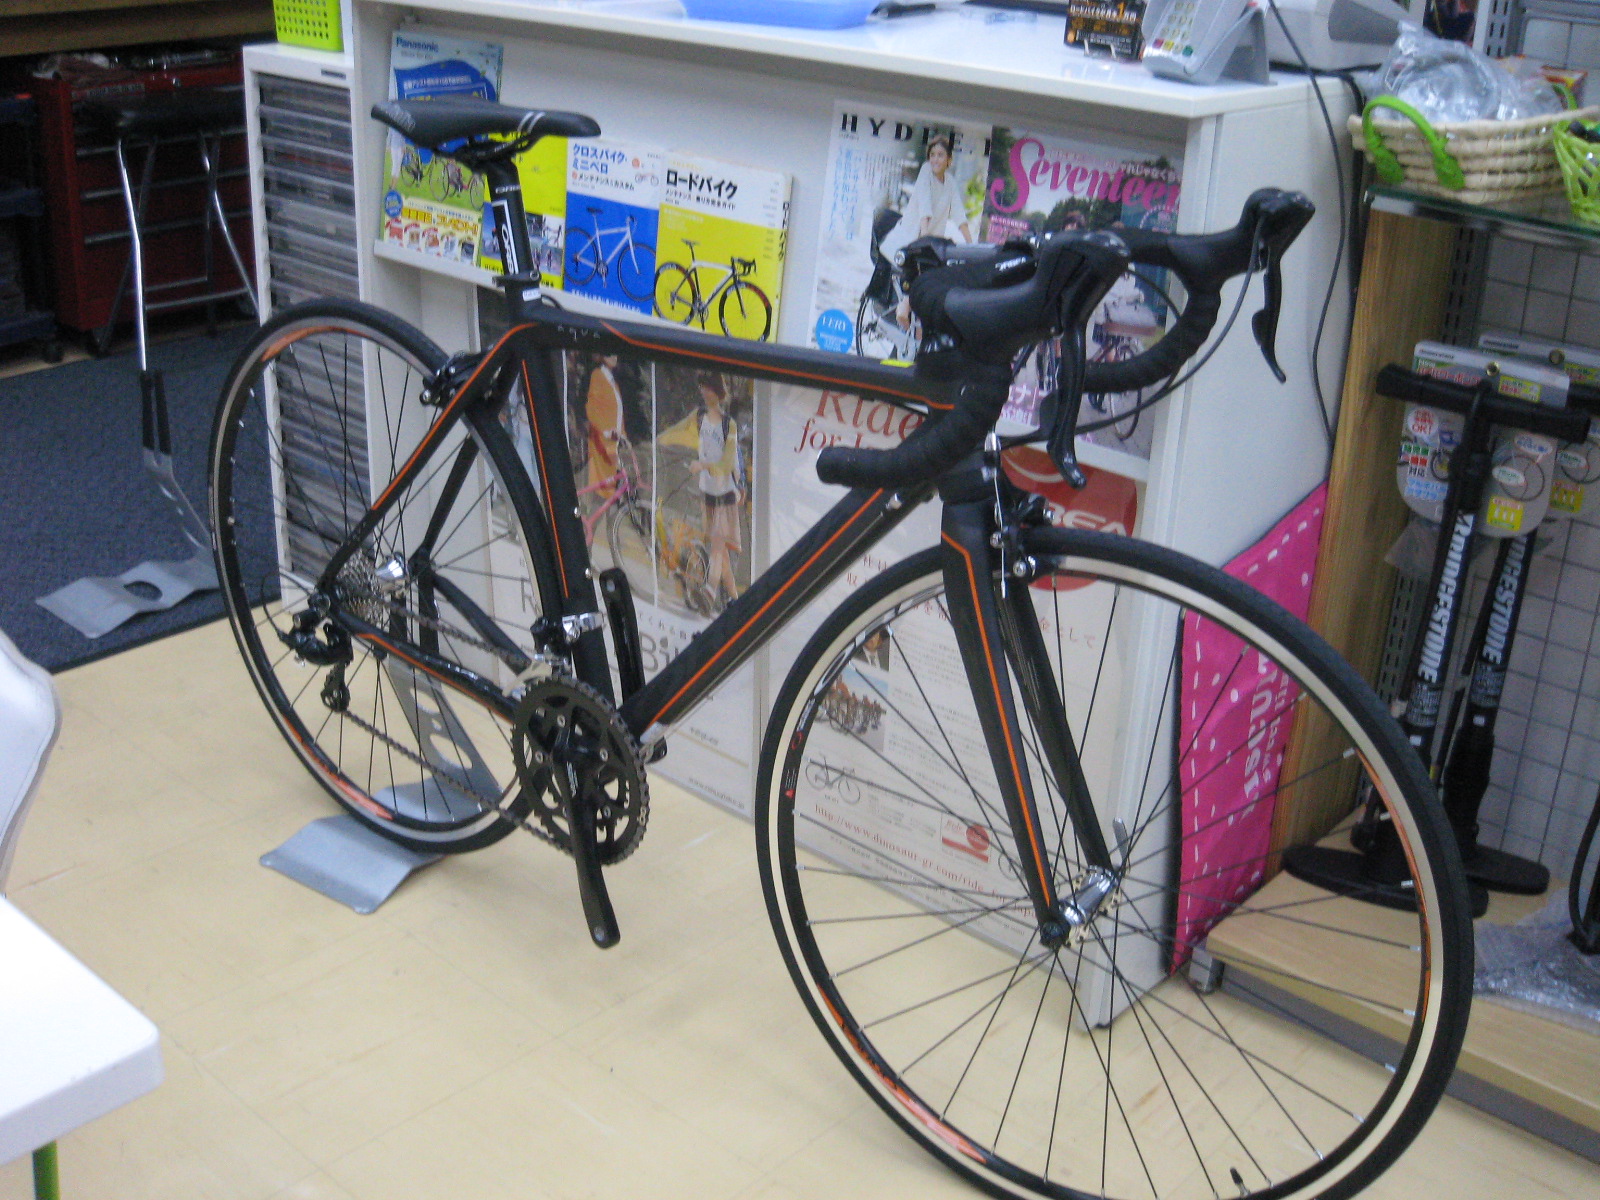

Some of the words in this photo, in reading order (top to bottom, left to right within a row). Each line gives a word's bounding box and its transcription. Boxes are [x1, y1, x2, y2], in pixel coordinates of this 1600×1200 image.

[396, 36, 439, 54] Panasonic
[666, 169, 738, 200] ロードバイク
[794, 418, 842, 453] for
